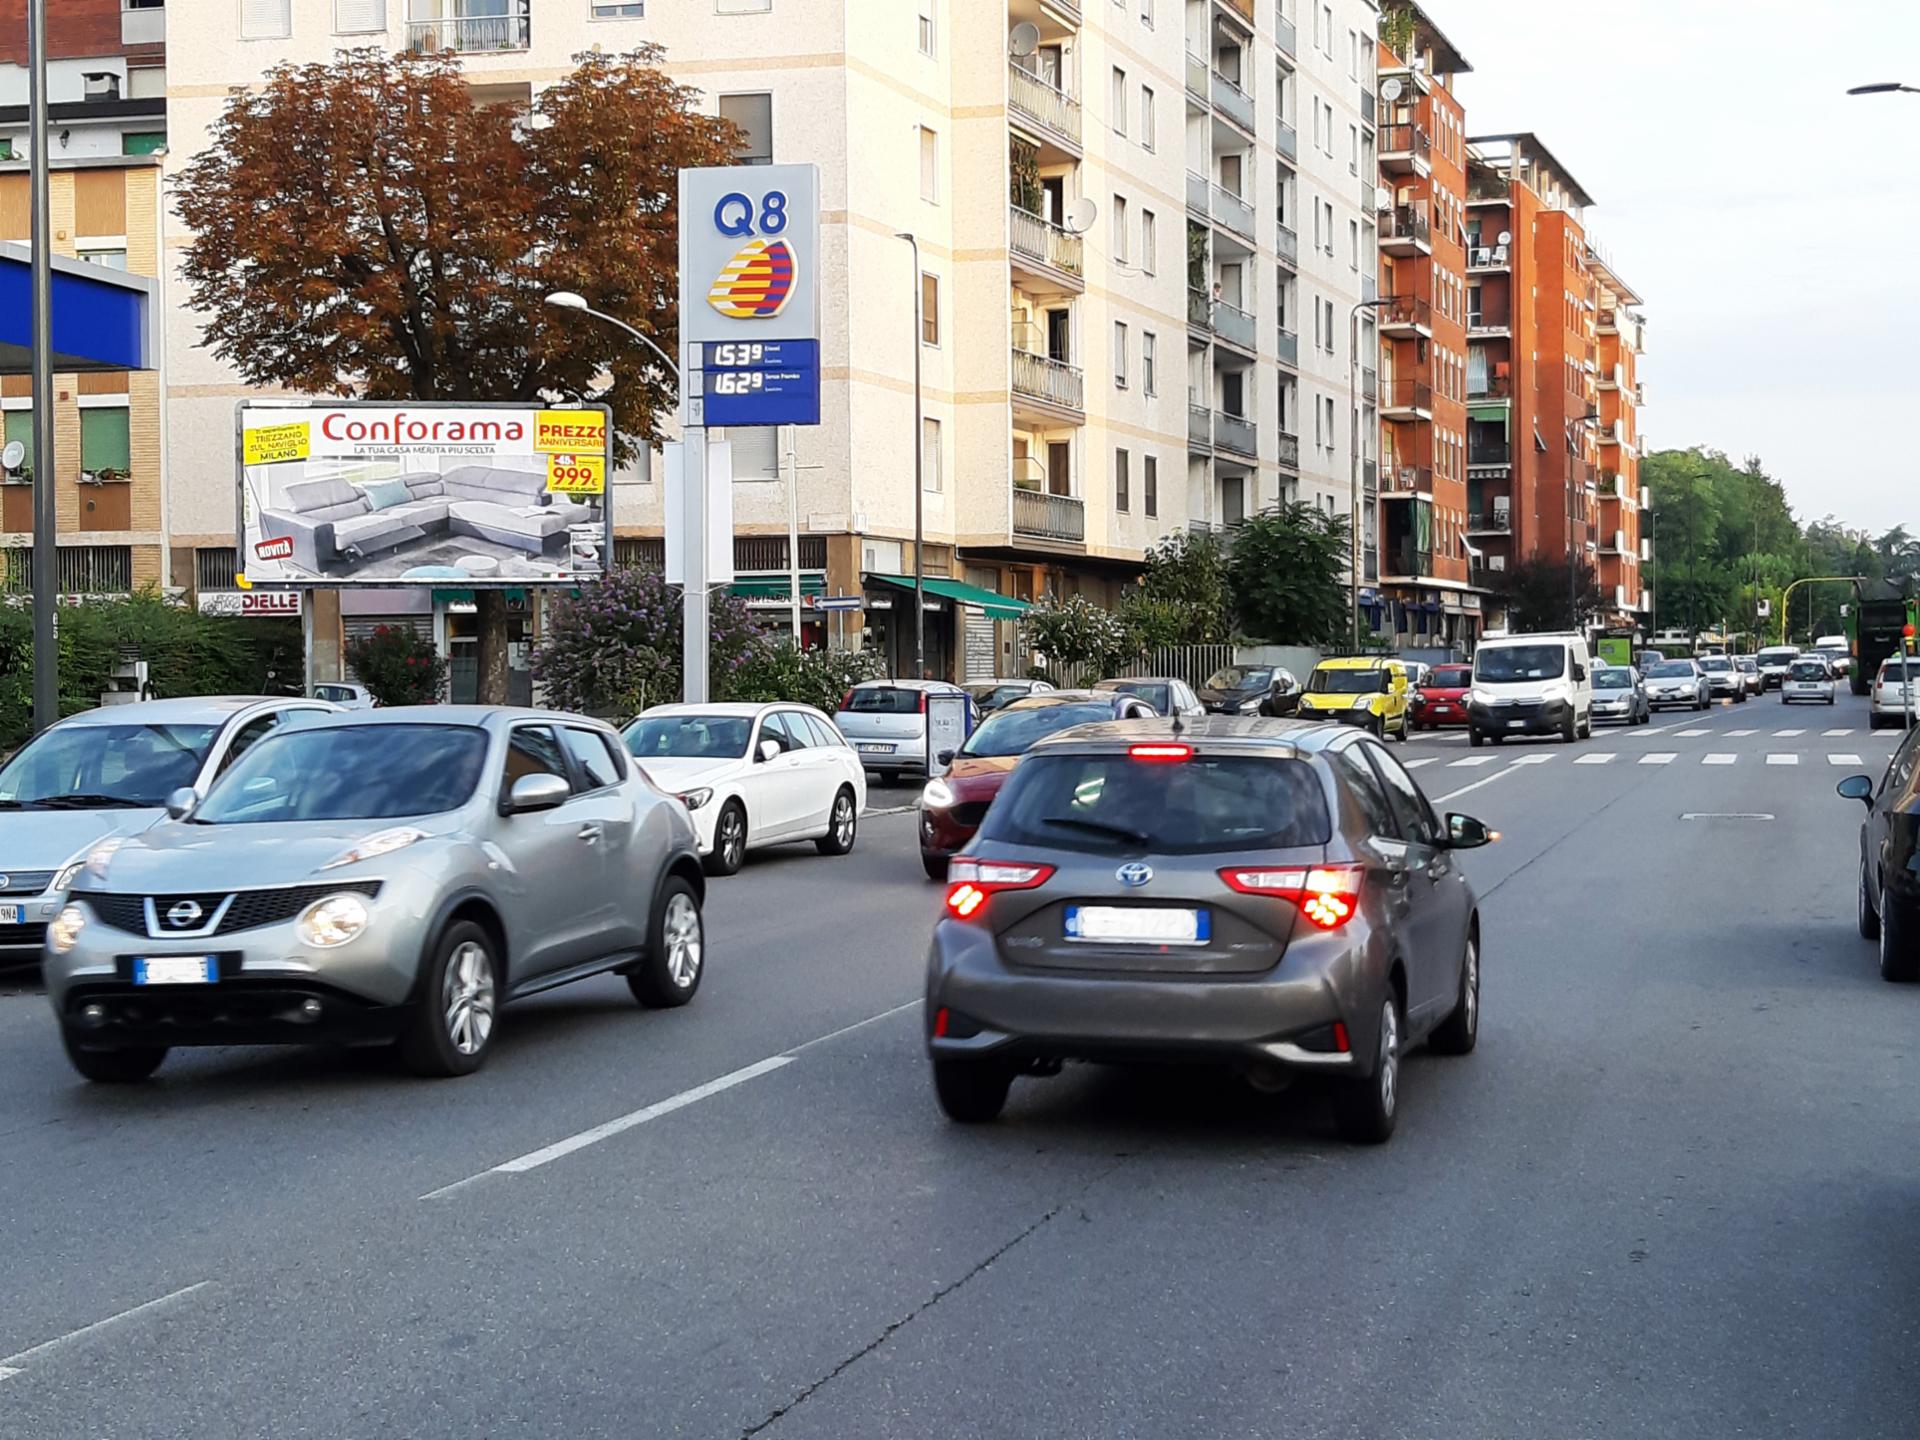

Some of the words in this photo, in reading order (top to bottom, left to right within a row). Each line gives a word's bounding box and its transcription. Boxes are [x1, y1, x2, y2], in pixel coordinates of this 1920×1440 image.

[713, 190, 788, 236] Q8
[322, 413, 523, 445] Conforama
[260, 449, 298, 460] MILANO
[354, 446, 366, 454] LA
[367, 446, 386, 454] TUA
[387, 446, 411, 454] CASA
[242, 593, 298, 608] DIELLE
